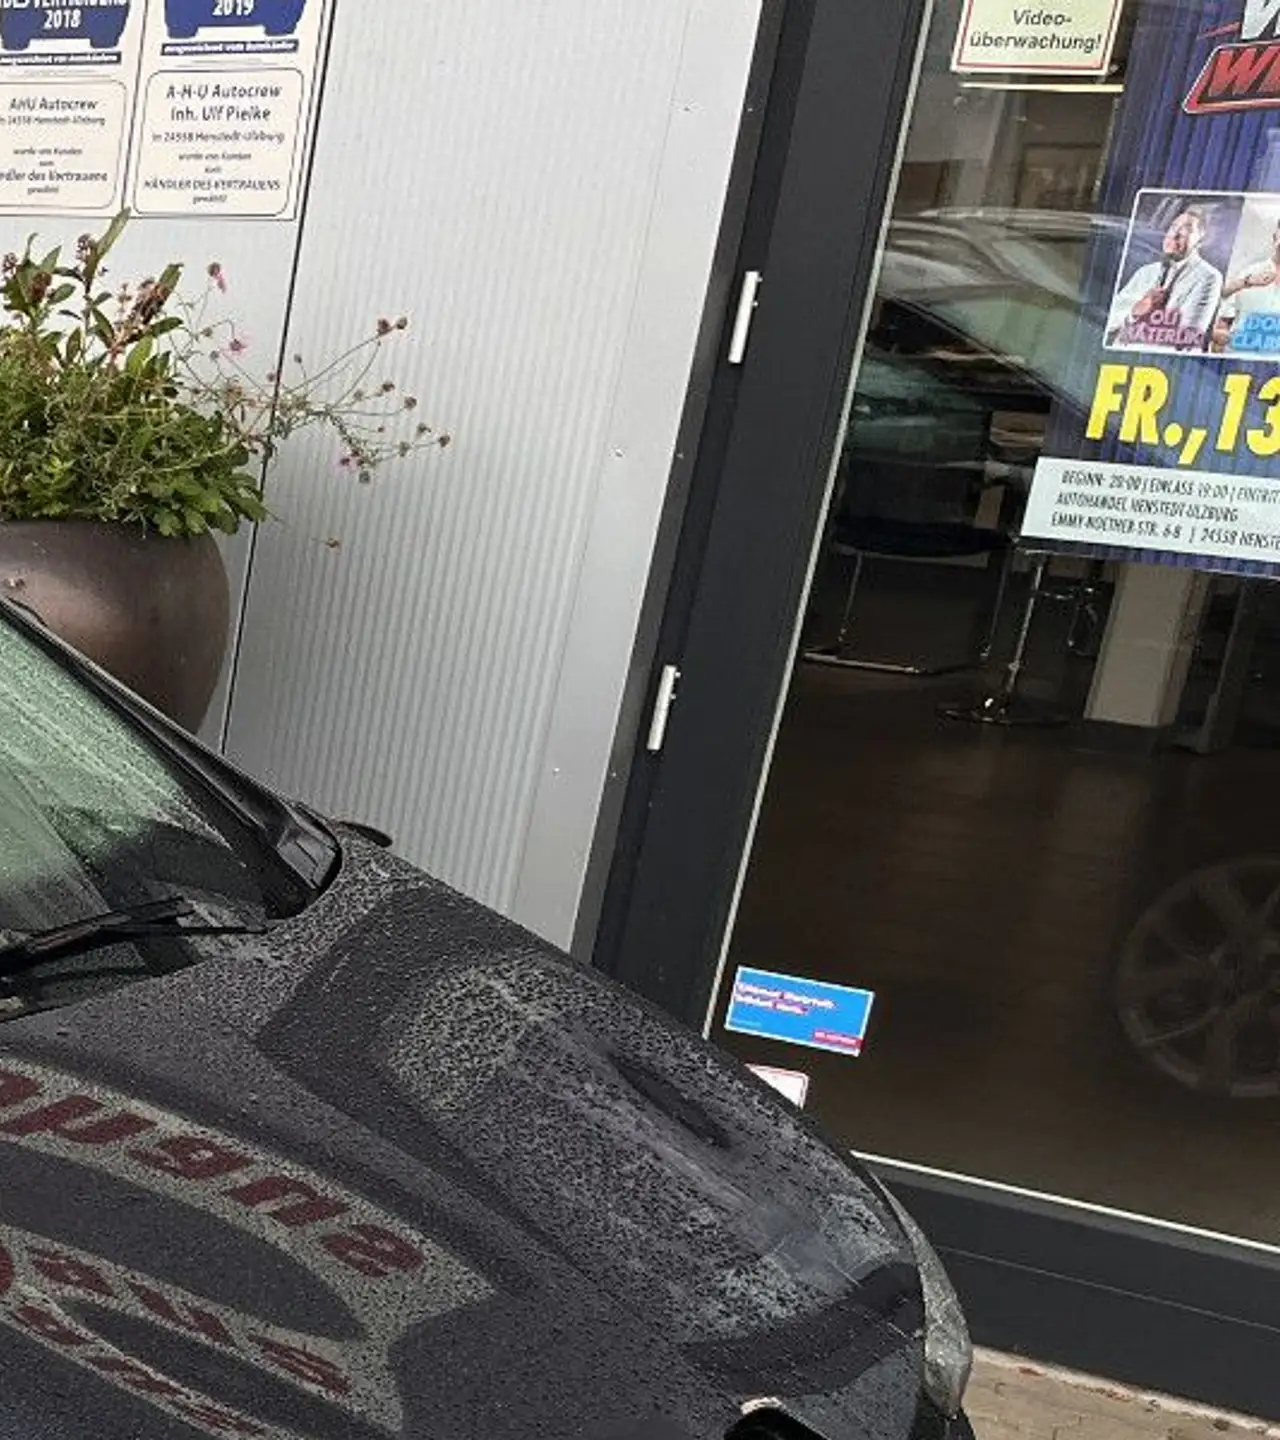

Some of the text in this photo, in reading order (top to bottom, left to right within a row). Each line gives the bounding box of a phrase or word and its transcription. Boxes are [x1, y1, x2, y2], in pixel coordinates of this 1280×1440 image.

[43, 9, 81, 30] 2018
[1012, 8, 1073, 27] Video-
[969, 31, 1103, 53] überwachung!
[166, 84, 282, 99] A-H-U Autocrew
[8, 97, 99, 111] AHU Autocrew
[170, 105, 199, 121] Inh.
